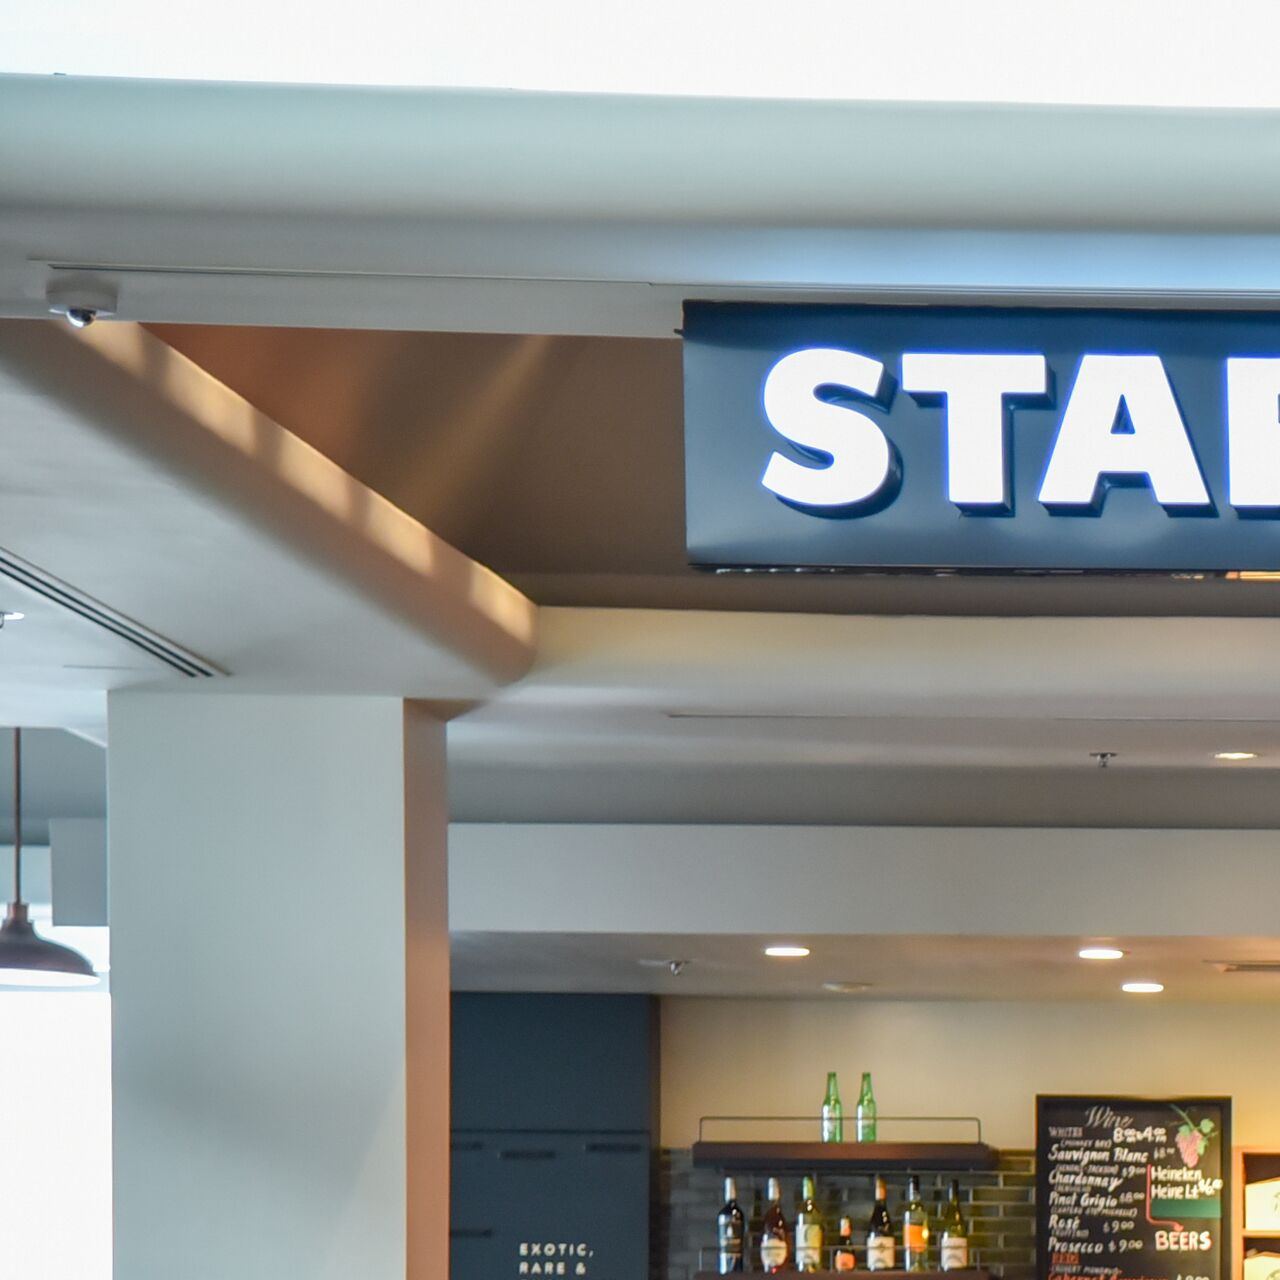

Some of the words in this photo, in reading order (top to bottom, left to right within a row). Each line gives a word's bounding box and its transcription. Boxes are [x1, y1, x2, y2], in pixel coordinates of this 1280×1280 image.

[1085, 1106, 1134, 1128] Wine
[1048, 1144, 1109, 1165] Sauvignon
[1113, 1147, 1149, 1163] Blanc
[1049, 1171, 1124, 1191] Chardonnay
[1151, 1165, 1202, 1182] Heineken
[1049, 1191, 1076, 1207] Pinot
[1080, 1194, 1117, 1213] Grigio
[1048, 1237, 1103, 1254] Prosecco
[1155, 1231, 1213, 1250] BEERS
[519, 1243, 593, 1258] EXOTIC,
[519, 1261, 566, 1275] RARE
[575, 1261, 586, 1275] &
